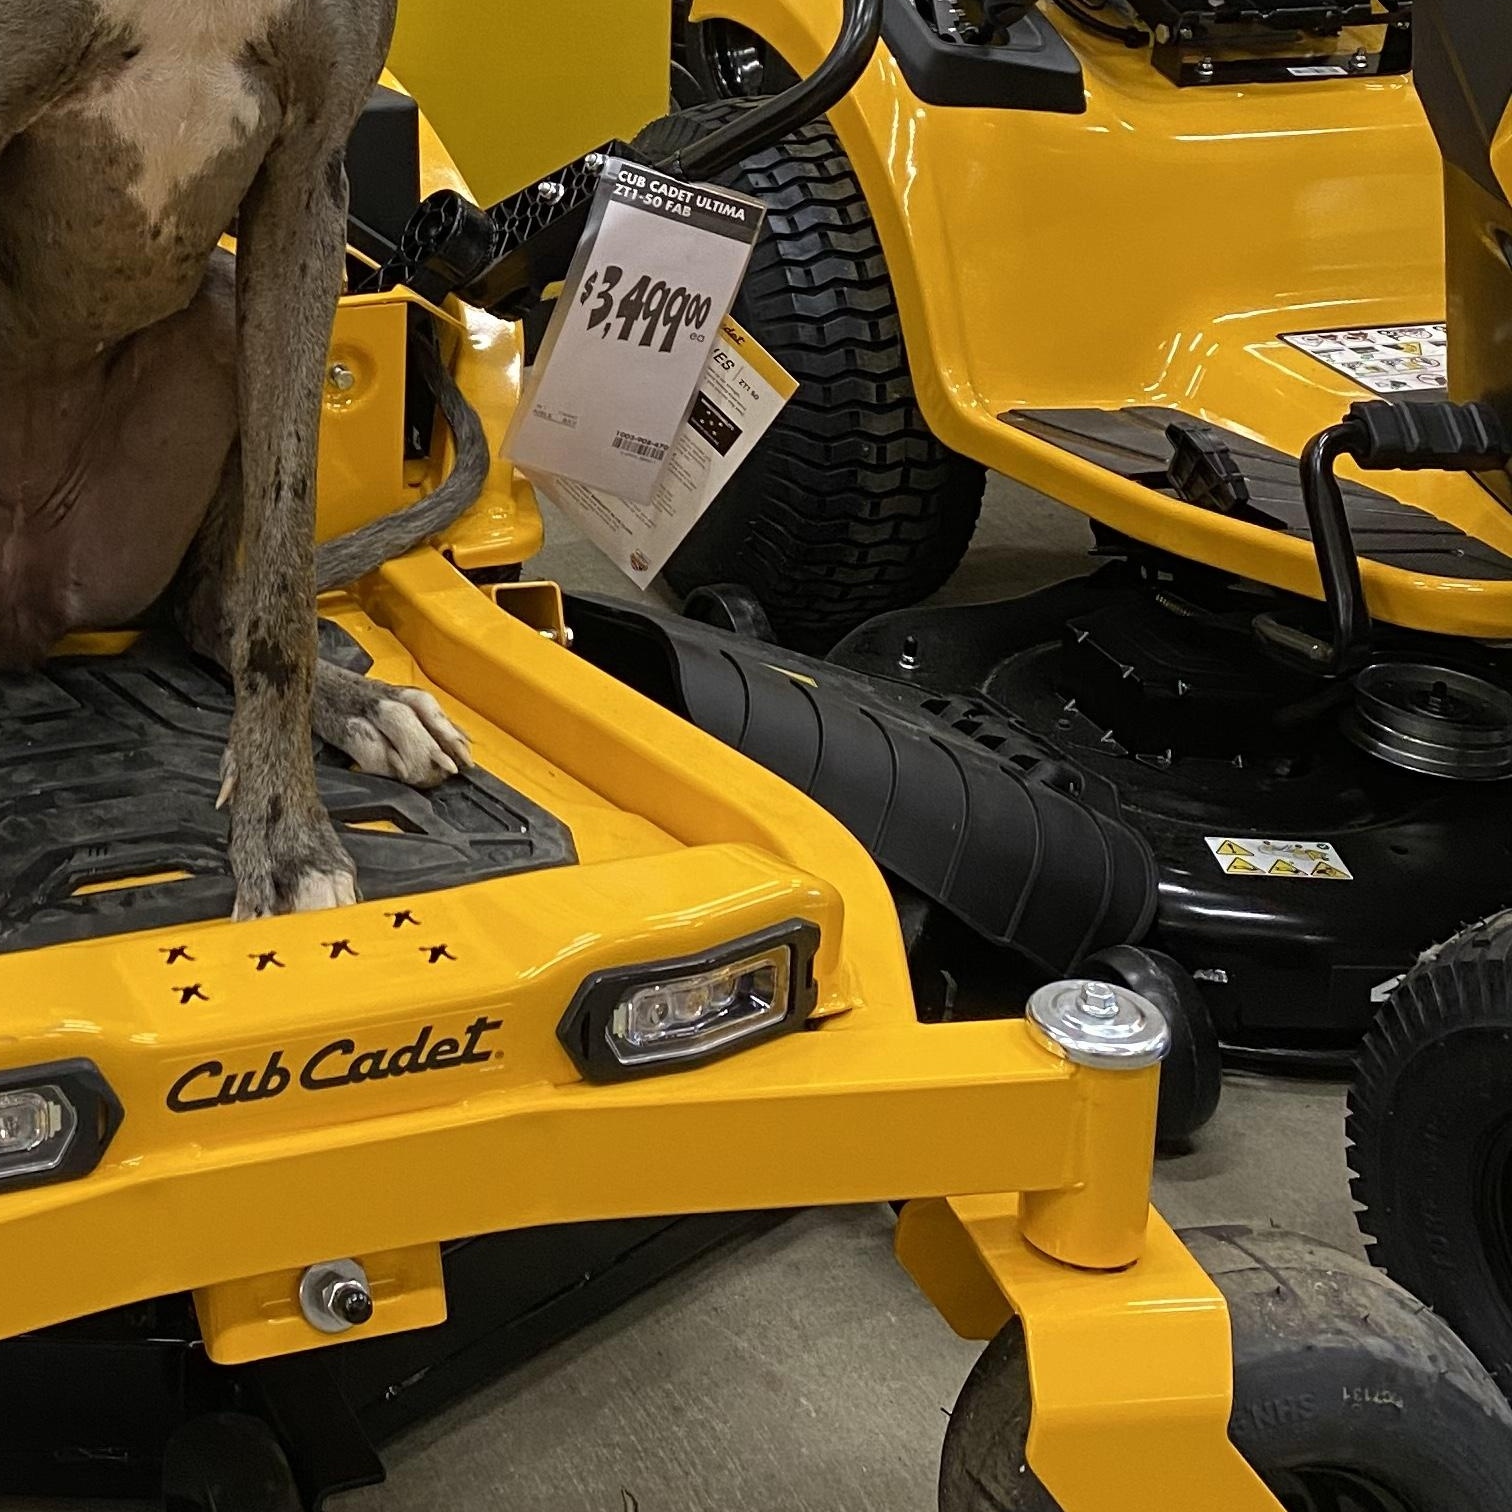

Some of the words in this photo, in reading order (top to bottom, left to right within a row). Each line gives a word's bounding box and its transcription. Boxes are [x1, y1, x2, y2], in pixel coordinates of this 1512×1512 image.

[612, 183, 664, 209] ZT1-50
[664, 200, 692, 218] FAB
[618, 170, 647, 189] CUB
[649, 179, 695, 204] CADET
[695, 194, 746, 222] ULTIMA
[579, 265, 712, 354] $3,49900
[689, 332, 705, 344] ea
[167, 1056, 293, 1115] Cub
[299, 1015, 504, 1089] Cadet
